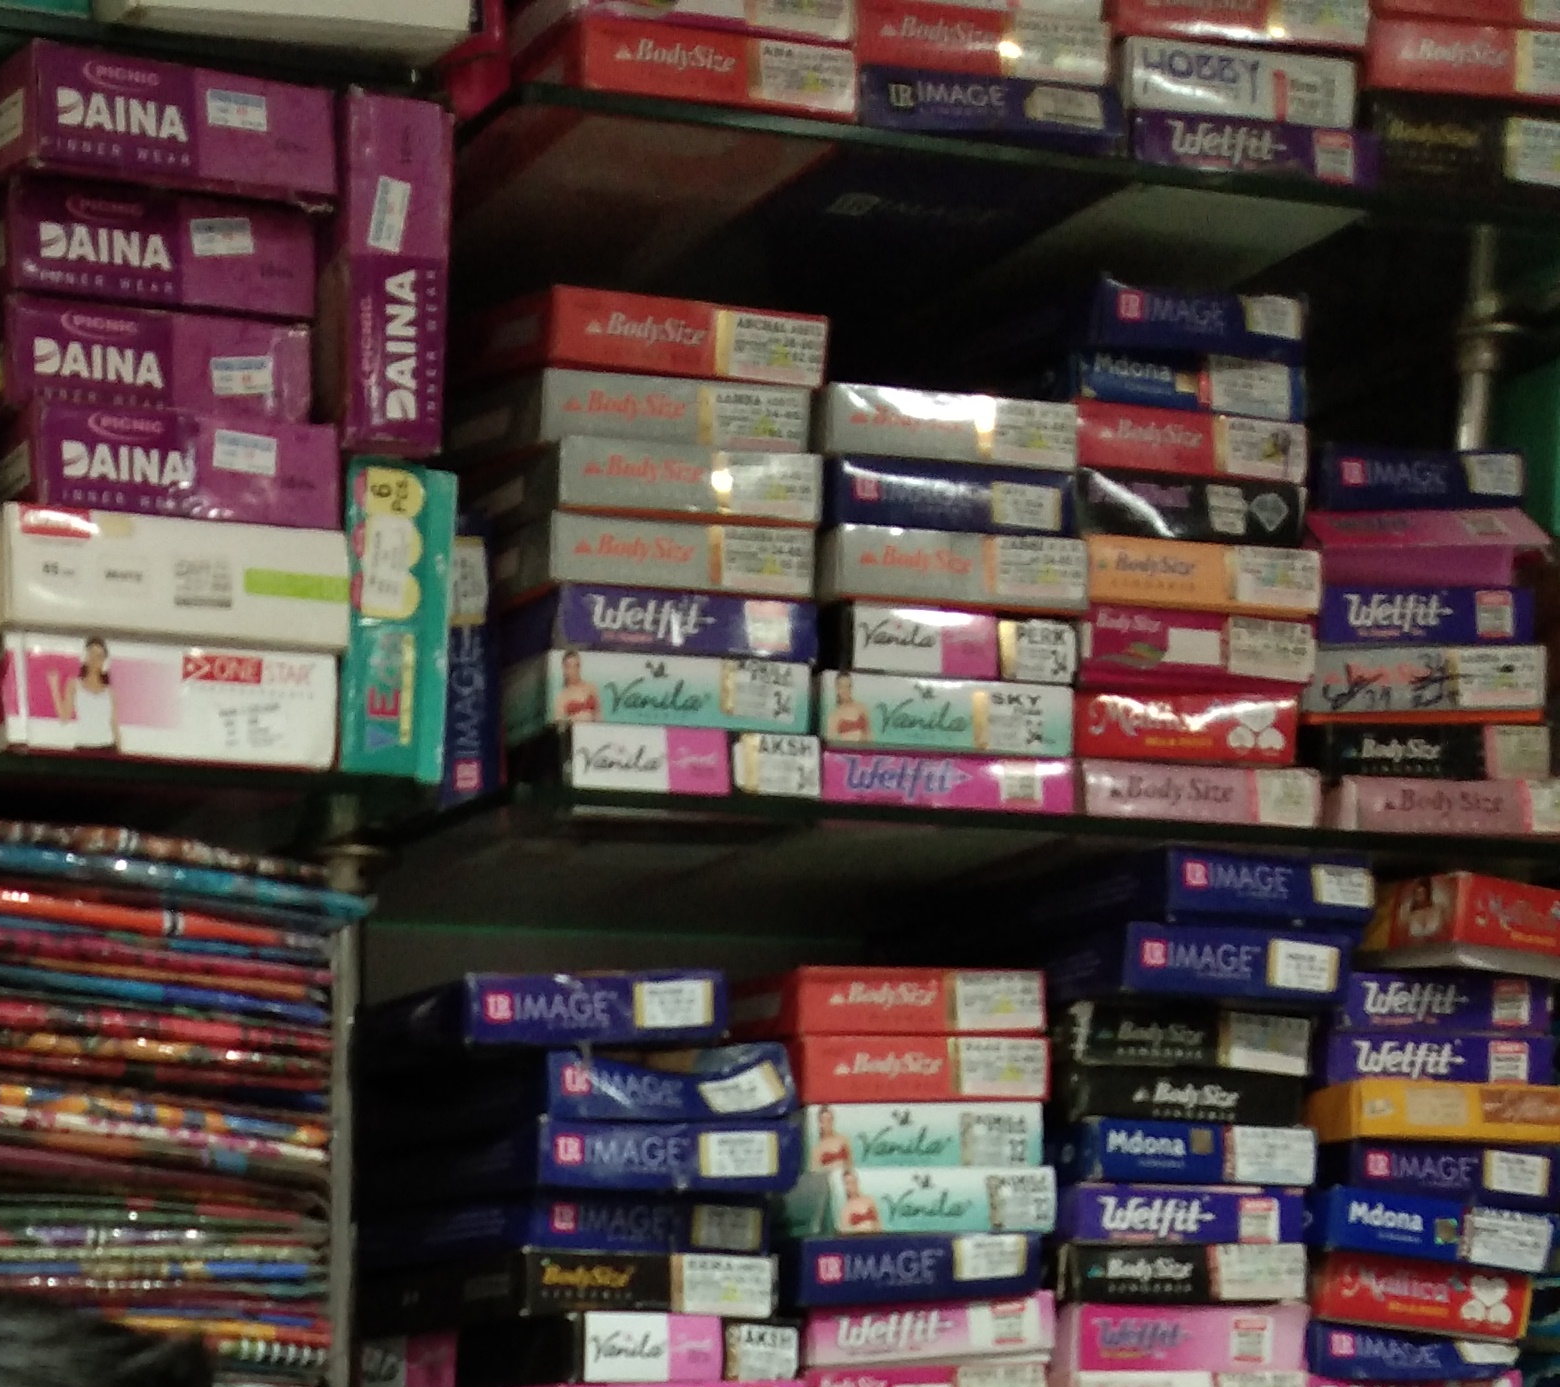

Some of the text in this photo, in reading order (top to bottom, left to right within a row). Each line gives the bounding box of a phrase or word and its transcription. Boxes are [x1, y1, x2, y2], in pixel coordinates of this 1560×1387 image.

[917, 82, 1006, 107] IMAGE
[57, 88, 189, 142] DAINA
[1166, 118, 1287, 165] Welfit
[40, 221, 173, 272] DAINA
[33, 337, 163, 389] DAINA
[385, 269, 419, 421] DAINA
[61, 439, 192, 487] DAINA
[587, 594, 717, 645] Welfit
[1343, 593, 1454, 632] Welfit
[215, 662, 255, 683] ONE
[451, 628, 485, 757] IMAGE
[990, 691, 1043, 706] SKY
[840, 754, 972, 798] Welfit
[1209, 864, 1293, 891] IMAGE
[1168, 942, 1261, 973] IMAGE
[514, 992, 619, 1022] IMAGE
[1360, 980, 1470, 1022] Welfit
[1351, 1038, 1466, 1079] Welfit
[585, 1136, 690, 1166] IMAGE
[1391, 1153, 1480, 1184] IMAGE
[578, 1206, 670, 1234] IMAGE
[1097, 1194, 1216, 1238] Welfit
[844, 1250, 942, 1278] IMAGE
[836, 1311, 954, 1350] Welfit
